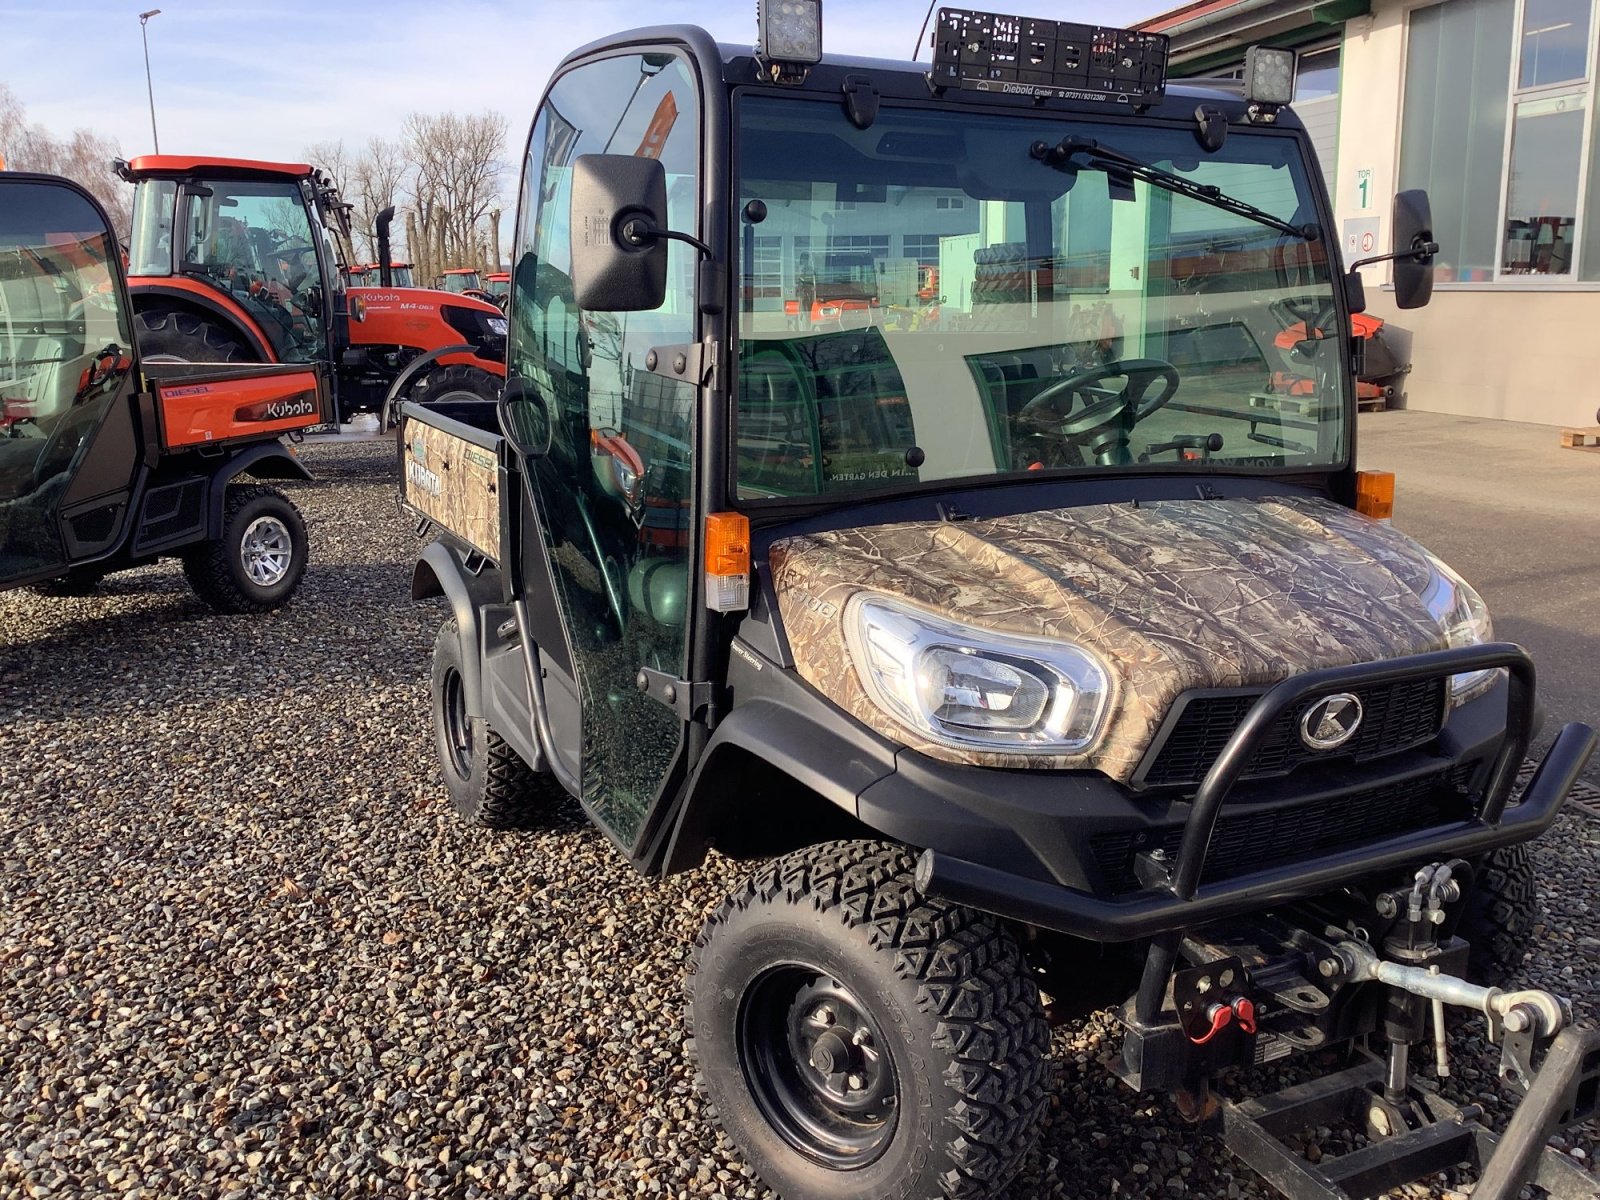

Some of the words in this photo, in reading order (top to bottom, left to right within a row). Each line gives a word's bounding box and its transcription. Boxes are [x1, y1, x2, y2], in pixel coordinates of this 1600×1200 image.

[1003, 83, 1034, 95] Diebold
[1034, 88, 1053, 97] GmbH
[1357, 169, 1371, 179] TOR
[1359, 179, 1368, 208] 1
[363, 293, 400, 302] Kubota
[163, 386, 214, 399] DIESEL
[267, 399, 313, 418] Kubota
[407, 460, 441, 497] KUBOTA
[743, 650, 763, 671] Steering
